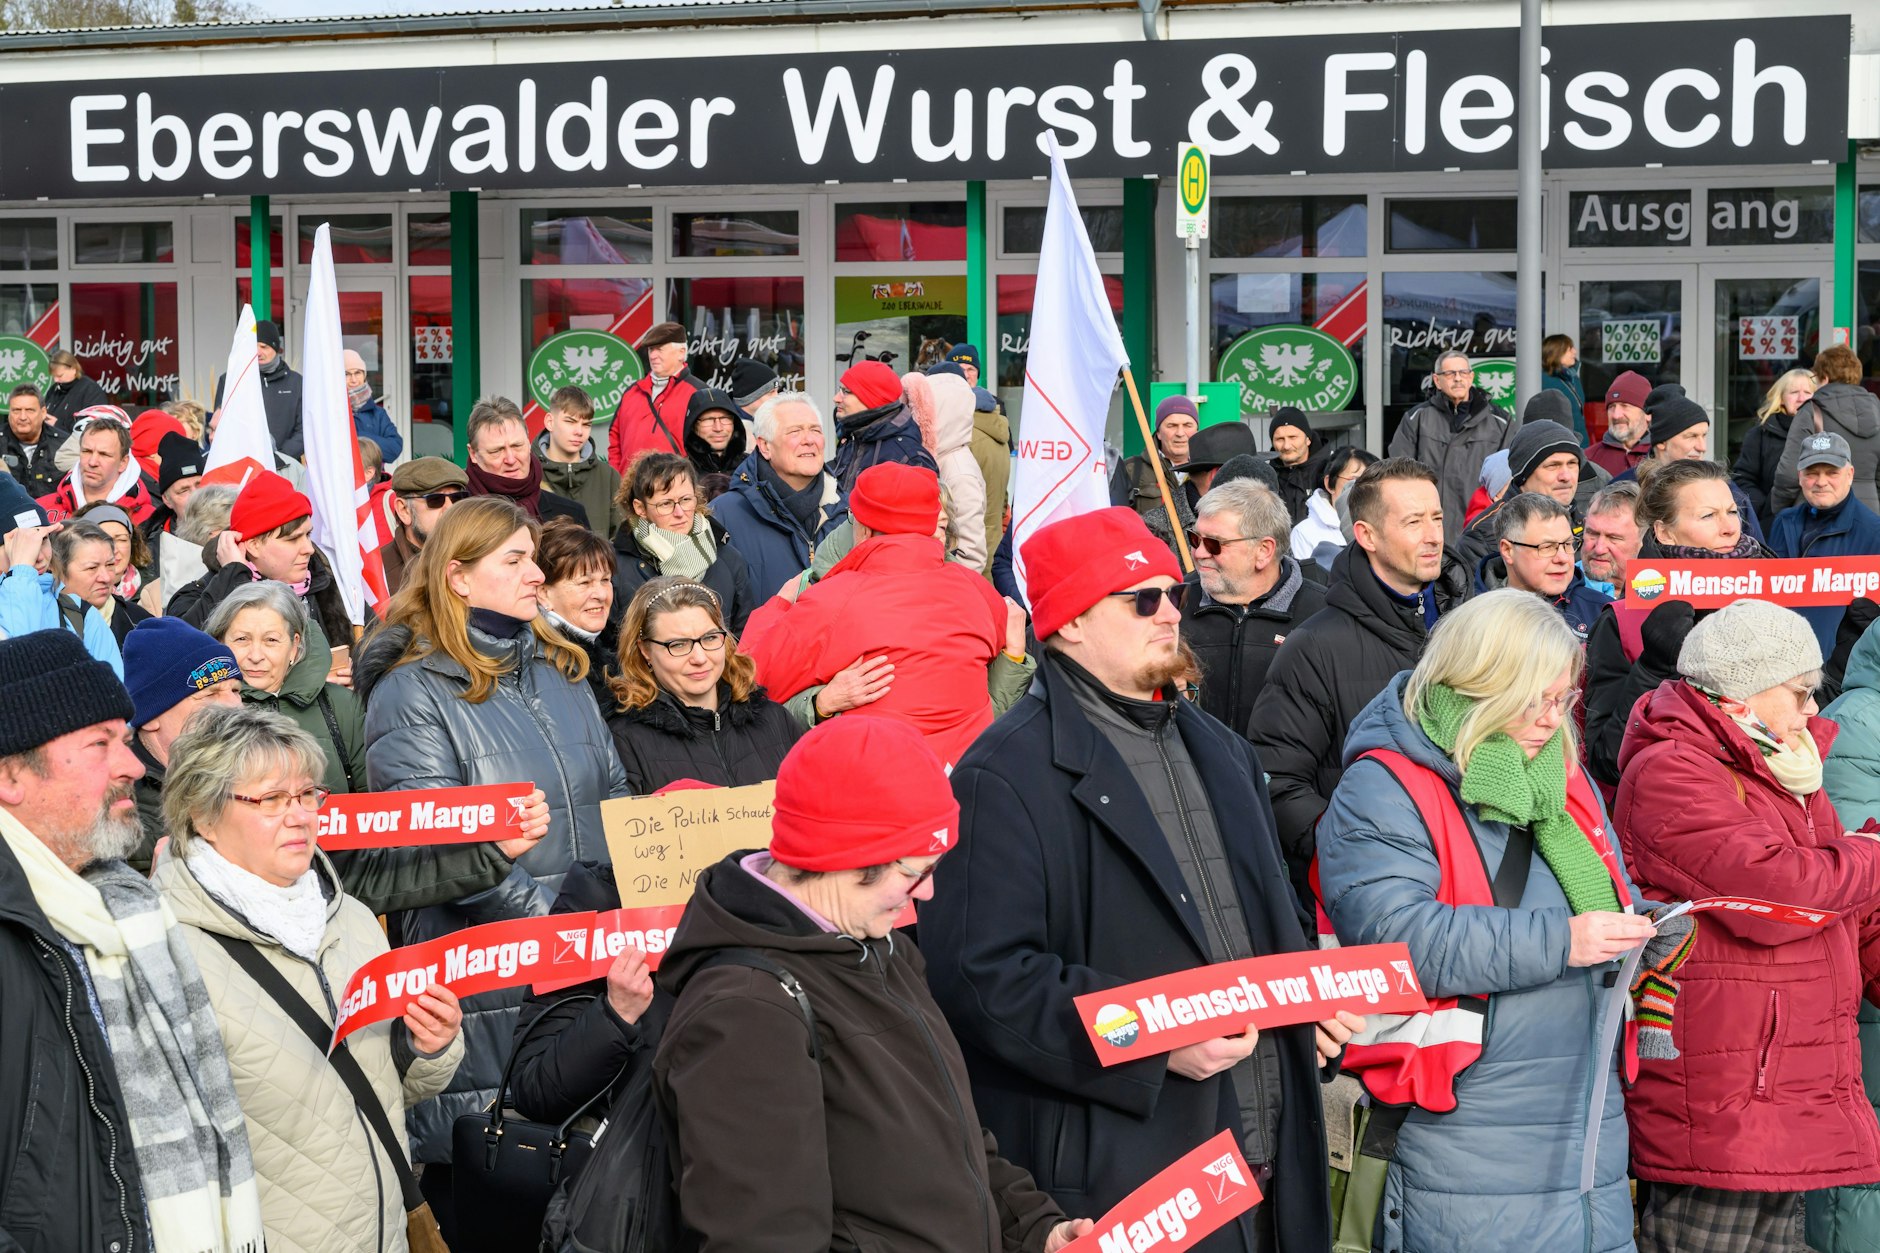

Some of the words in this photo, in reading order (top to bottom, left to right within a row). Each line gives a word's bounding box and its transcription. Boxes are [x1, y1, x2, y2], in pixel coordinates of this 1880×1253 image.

[70, 76, 736, 182] Eberswalder
[783, 59, 1151, 165] Wurst
[1188, 53, 1280, 156] &
[74, 330, 133, 366] Richtig
[133, 336, 173, 366] gut
[687, 326, 740, 366] chtig
[1390, 316, 1474, 353] Richtig
[97, 369, 121, 394] die
[125, 373, 179, 393] Wurst
[1669, 570, 1763, 596] Mensch
[1770, 574, 1806, 594] vor
[1812, 567, 1880, 597] Marge
[356, 810, 402, 834] vor
[410, 801, 495, 834] Marge
[625, 817, 665, 838] Die
[633, 874, 668, 893] Die
[338, 975, 377, 1026] sch
[386, 968, 440, 996] vor
[445, 939, 540, 984] Marge
[1136, 976, 1267, 1034] Mensch
[1266, 976, 1313, 1005] vor
[1309, 965, 1389, 1004] Marge
[1213, 1155, 1233, 1174] NGG
[1098, 1187, 1202, 1253] Marge
